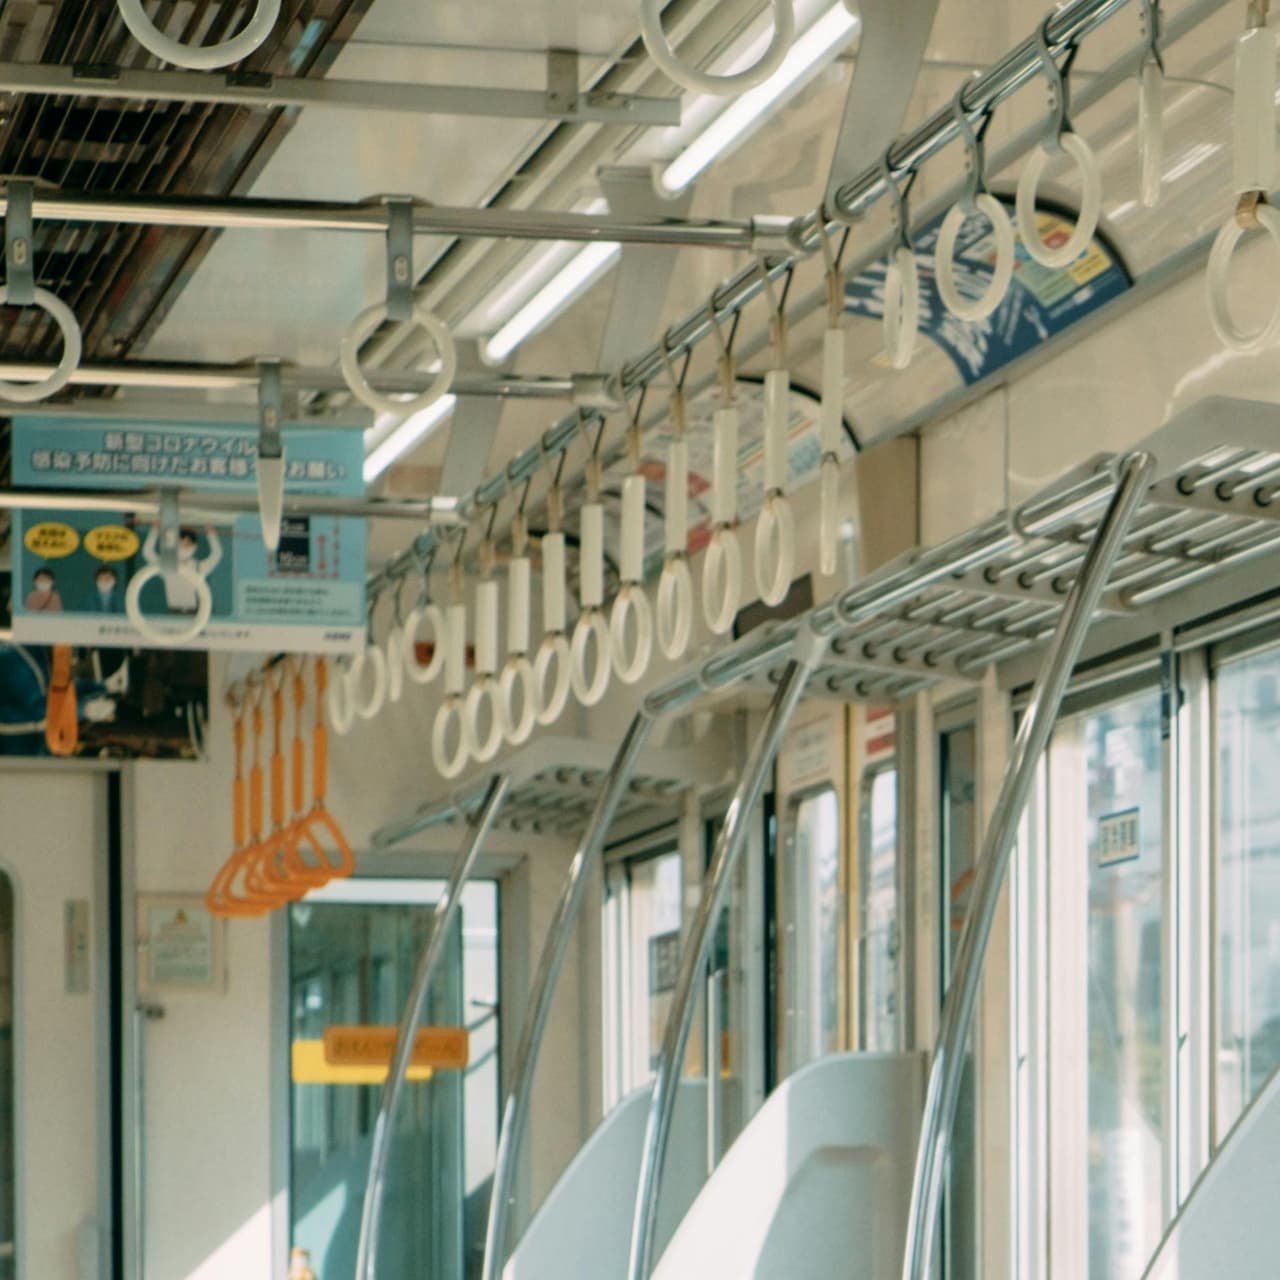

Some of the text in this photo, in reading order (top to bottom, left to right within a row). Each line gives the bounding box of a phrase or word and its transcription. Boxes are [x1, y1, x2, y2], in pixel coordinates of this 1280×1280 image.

[104, 431, 258, 456] 新型コロナウイル
